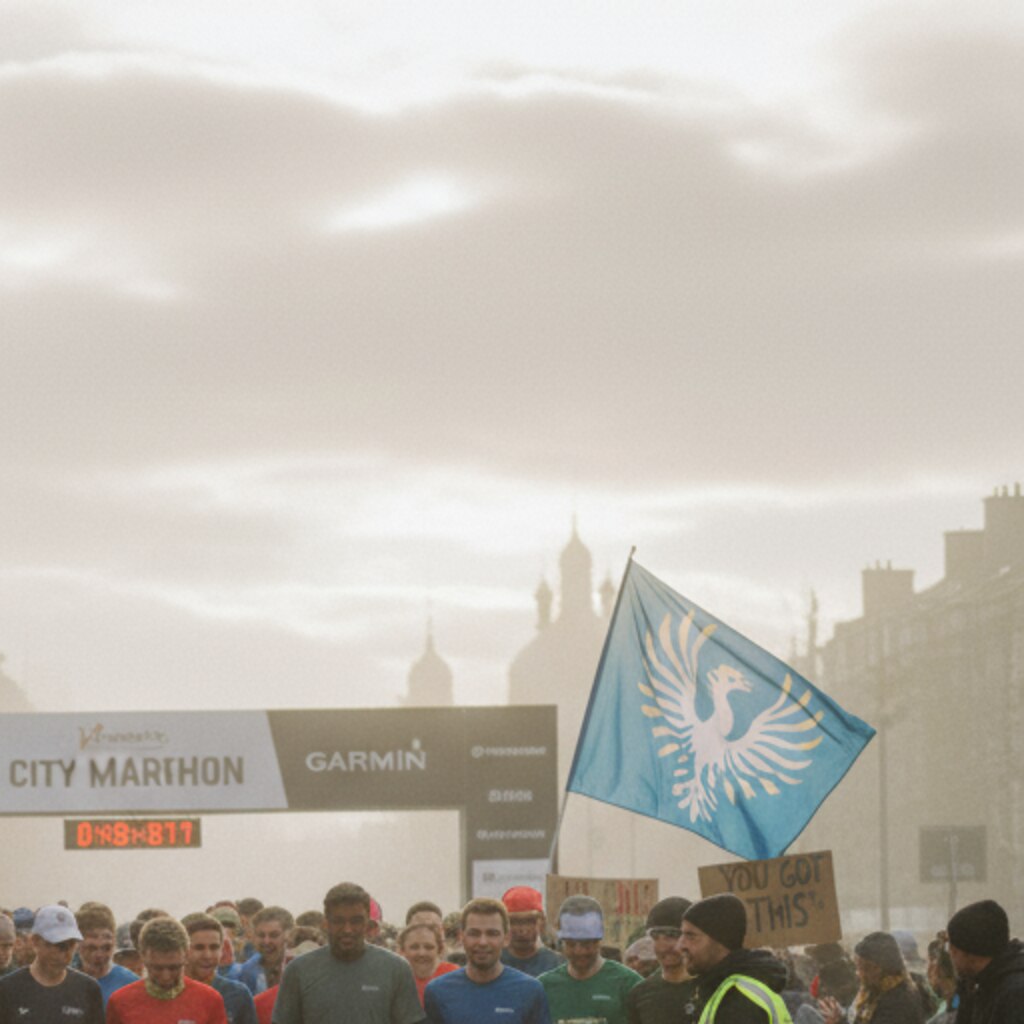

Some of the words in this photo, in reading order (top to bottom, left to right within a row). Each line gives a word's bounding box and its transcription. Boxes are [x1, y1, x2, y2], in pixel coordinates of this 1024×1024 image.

[9, 758, 76, 788] CITY
[305, 750, 426, 772] GARMIN
[718, 862, 769, 892] YOU
[780, 854, 825, 889] GOT
